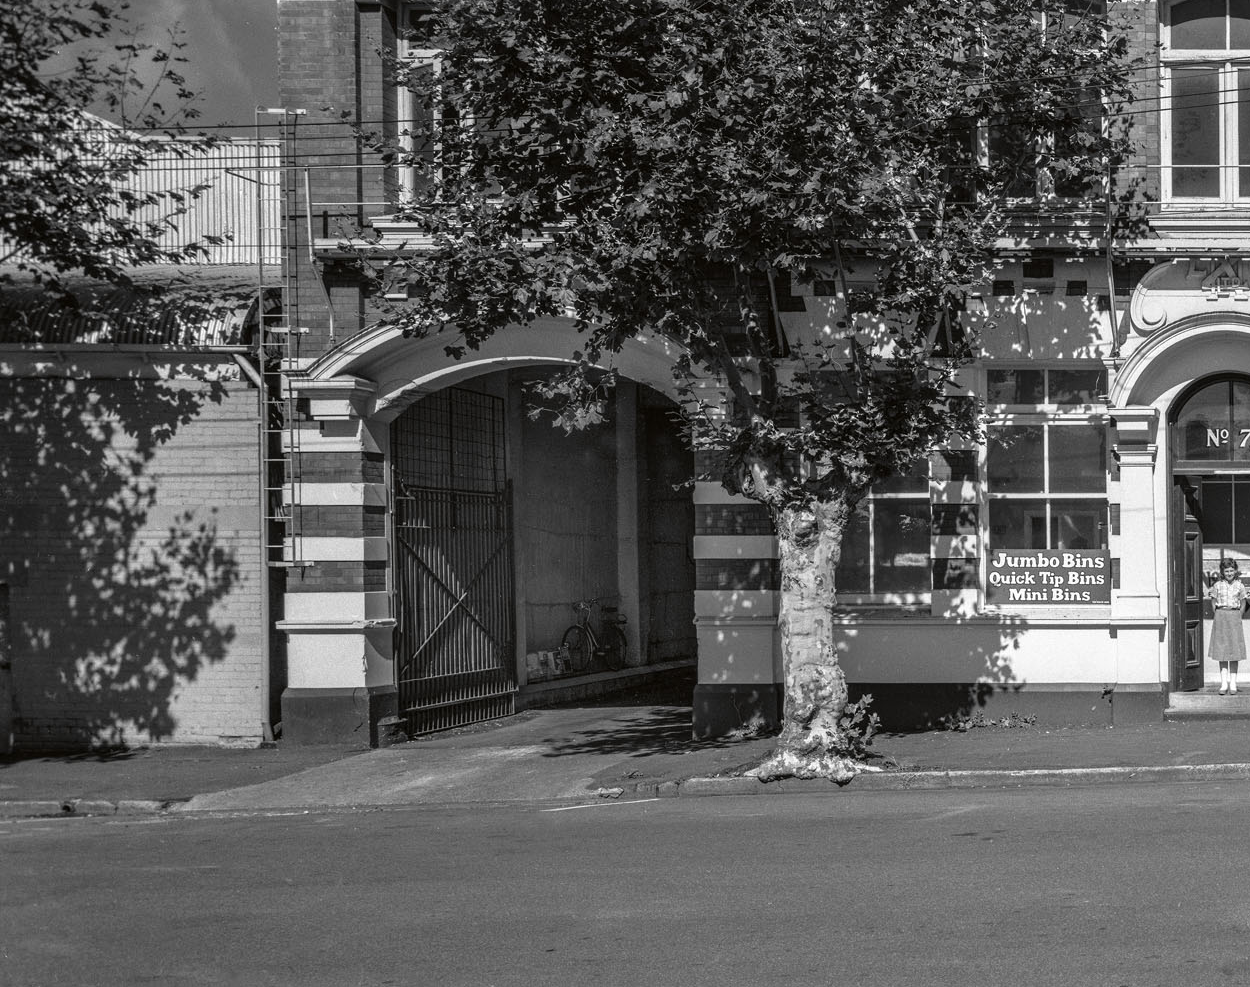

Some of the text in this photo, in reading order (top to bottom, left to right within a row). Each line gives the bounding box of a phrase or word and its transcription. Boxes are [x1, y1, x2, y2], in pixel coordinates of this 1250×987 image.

[992, 553, 1105, 569] Jumbo Bins
[989, 571, 1105, 588] Quick Tip Bins
[1008, 588, 1091, 601] Mini Bins
